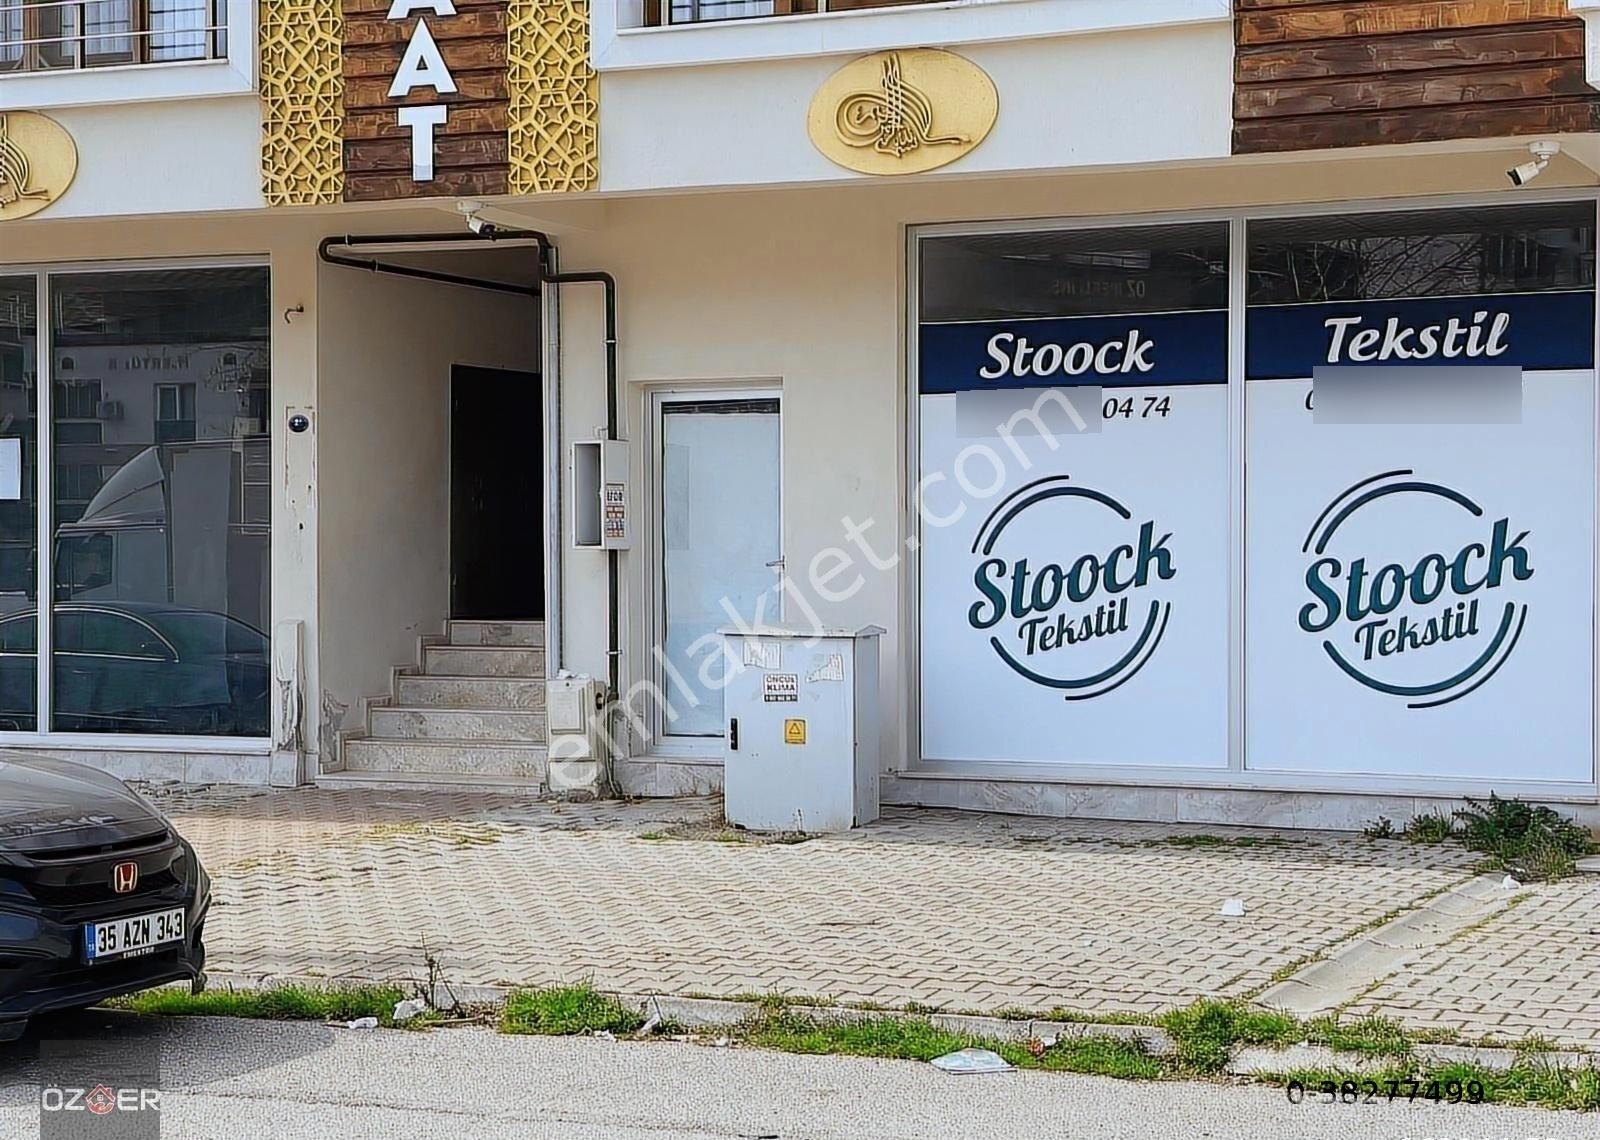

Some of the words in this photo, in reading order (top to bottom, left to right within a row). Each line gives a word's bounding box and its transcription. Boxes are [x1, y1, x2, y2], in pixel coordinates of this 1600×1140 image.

[386, 0, 459, 182] AT
[979, 329, 1155, 379] Stoock
[1324, 310, 1510, 363] Tekstil
[1102, 397, 1133, 419] 04
[1141, 396, 1171, 418] 74
[968, 520, 1177, 630] Stoock
[1299, 517, 1535, 633] Stoock
[1018, 597, 1129, 656] Tekstil
[1354, 598, 1479, 661] Tekstil
[98, 924, 117, 953] 35
[123, 918, 150, 948] AZN
[157, 912, 183, 940] 343
